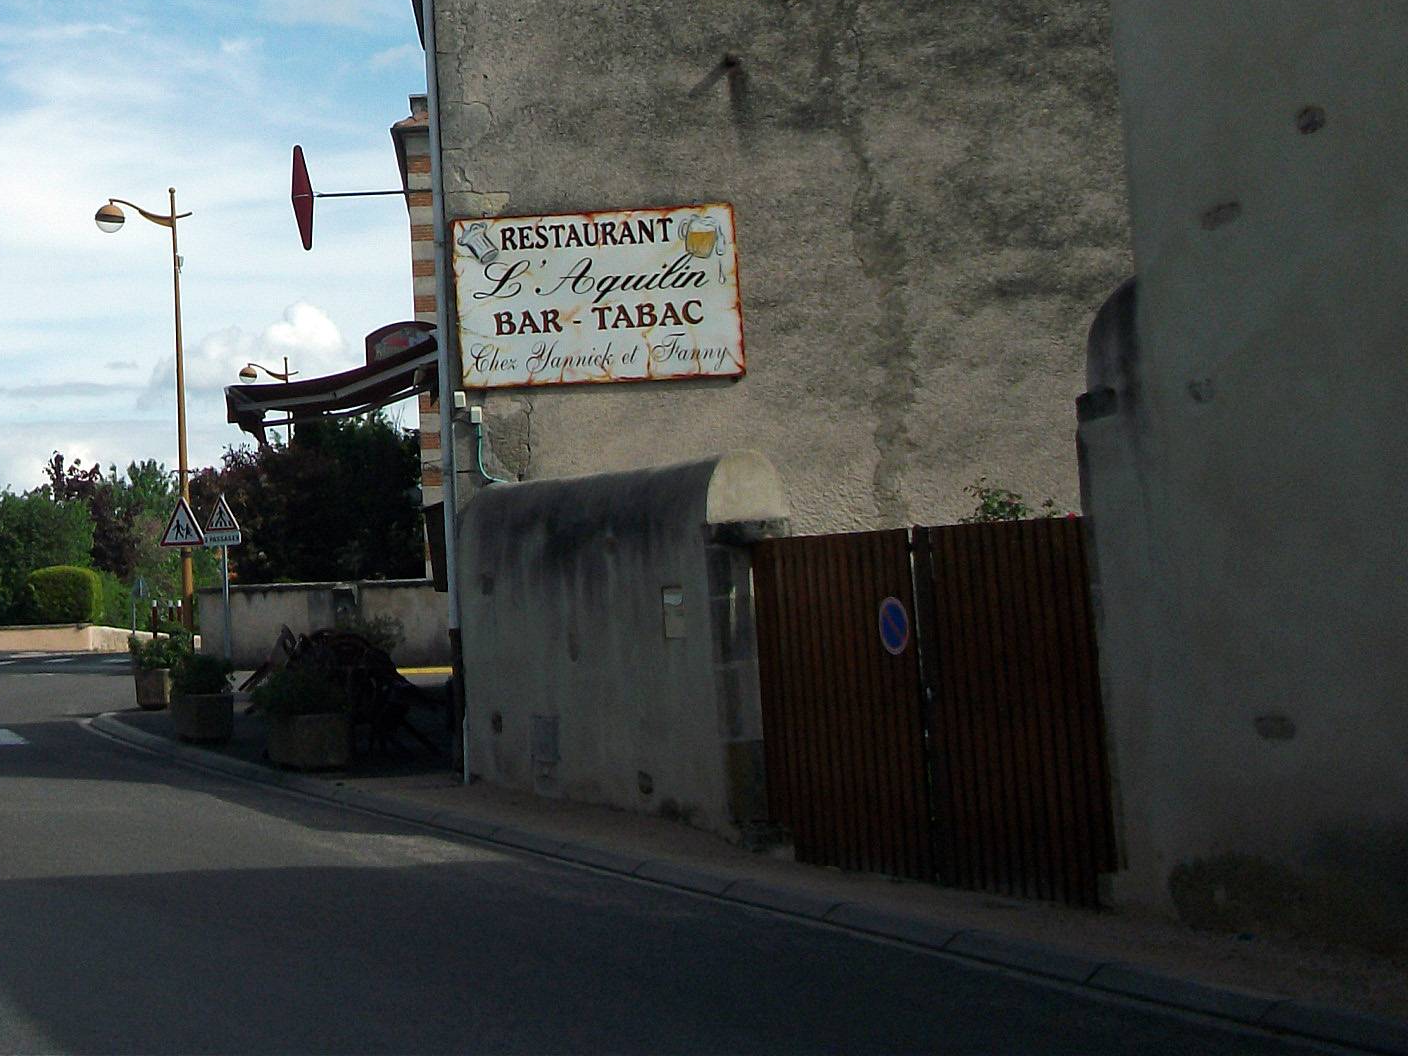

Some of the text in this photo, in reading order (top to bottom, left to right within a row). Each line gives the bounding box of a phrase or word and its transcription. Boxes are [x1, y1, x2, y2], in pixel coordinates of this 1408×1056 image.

[500, 217, 673, 251] RESTAURANT
[494, 308, 563, 336] BAR
[591, 300, 704, 330] TABAC
[470, 332, 728, 373] Chez Yannick et Fanny
